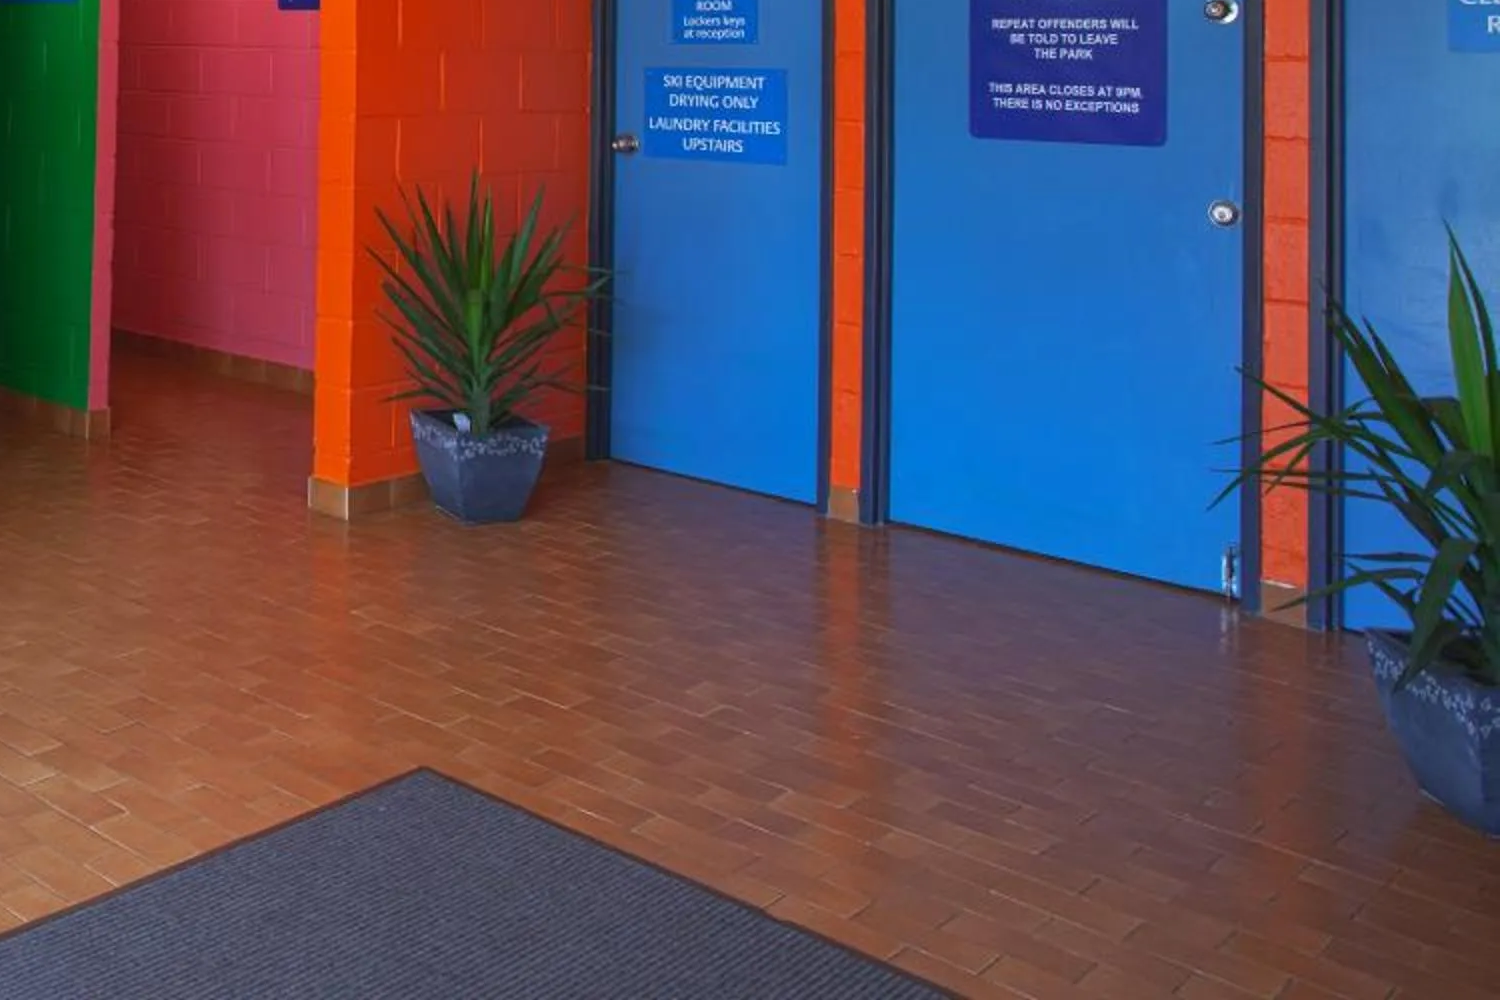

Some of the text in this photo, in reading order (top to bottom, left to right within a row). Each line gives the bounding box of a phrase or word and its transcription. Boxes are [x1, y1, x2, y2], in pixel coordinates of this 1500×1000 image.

[696, 0, 733, 11] ROOM
[991, 18, 1139, 30] REPEAT OFFENDERS WILL
[696, 28, 745, 41] reception
[1010, 33, 1119, 45] BE TOLD TO LEAVE
[1034, 48, 1093, 60] THE PARK
[663, 74, 765, 91] SKI EQUIPMENT
[988, 82, 1013, 93] THIS
[1015, 83, 1047, 95] AREA
[1049, 84, 1095, 96] CLOSES
[1097, 86, 1113, 97] AT
[669, 93, 759, 109] DRYING ONLY
[993, 97, 1140, 113] THERE IS NO EXCEPTIONS
[649, 117, 781, 135] LAUNDRY FACILITIES
[682, 137, 744, 153] UPSTAIRS
